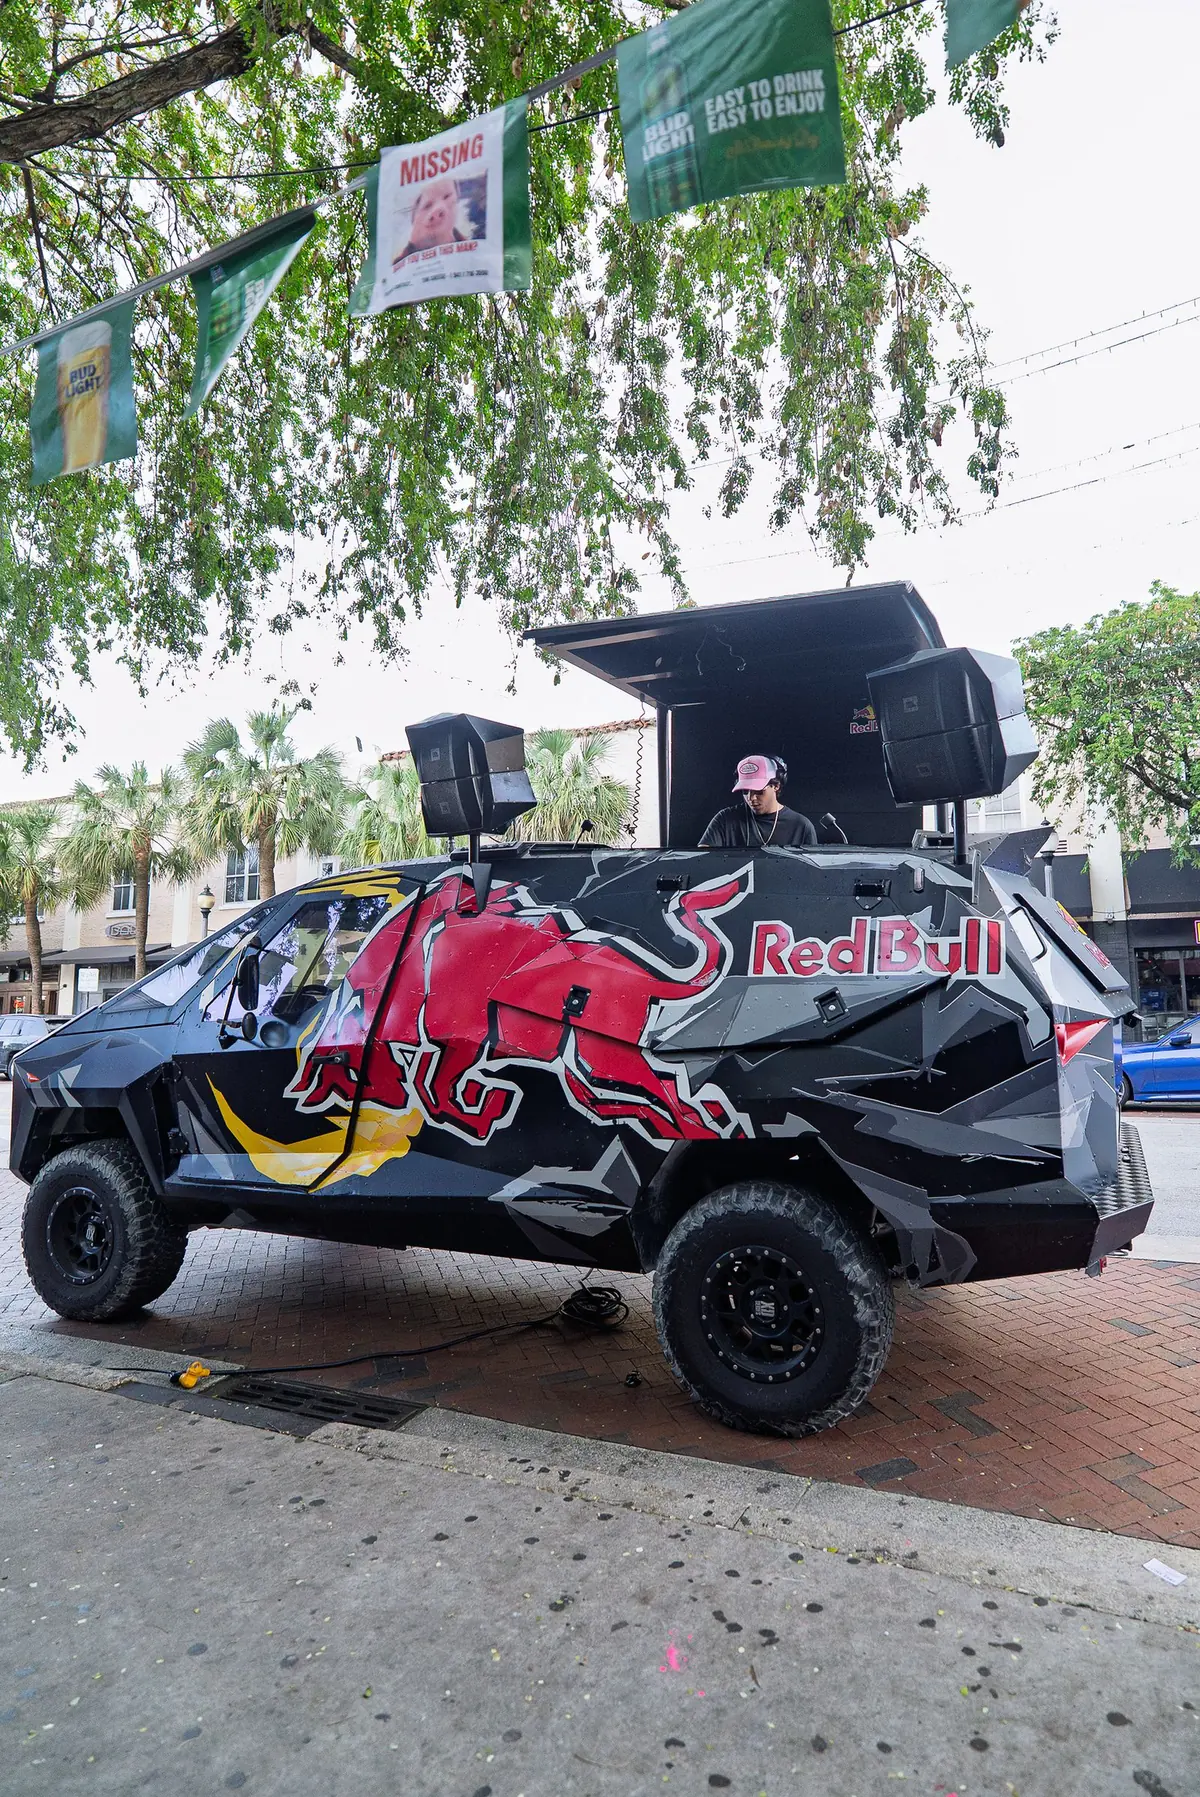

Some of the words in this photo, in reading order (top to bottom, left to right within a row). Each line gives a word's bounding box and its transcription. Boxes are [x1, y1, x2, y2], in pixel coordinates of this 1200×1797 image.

[704, 86, 745, 116] EASY
[747, 78, 771, 100] TO
[773, 69, 825, 95] DRINK
[645, 111, 690, 143] BUD
[707, 104, 747, 135] EASY
[750, 98, 773, 121] TO
[775, 90, 826, 118] ENJOY
[400, 133, 484, 186] MISSING
[642, 124, 695, 161] LIGHT
[65, 376, 102, 398] LIGHT
[69, 364, 97, 383] BUD
